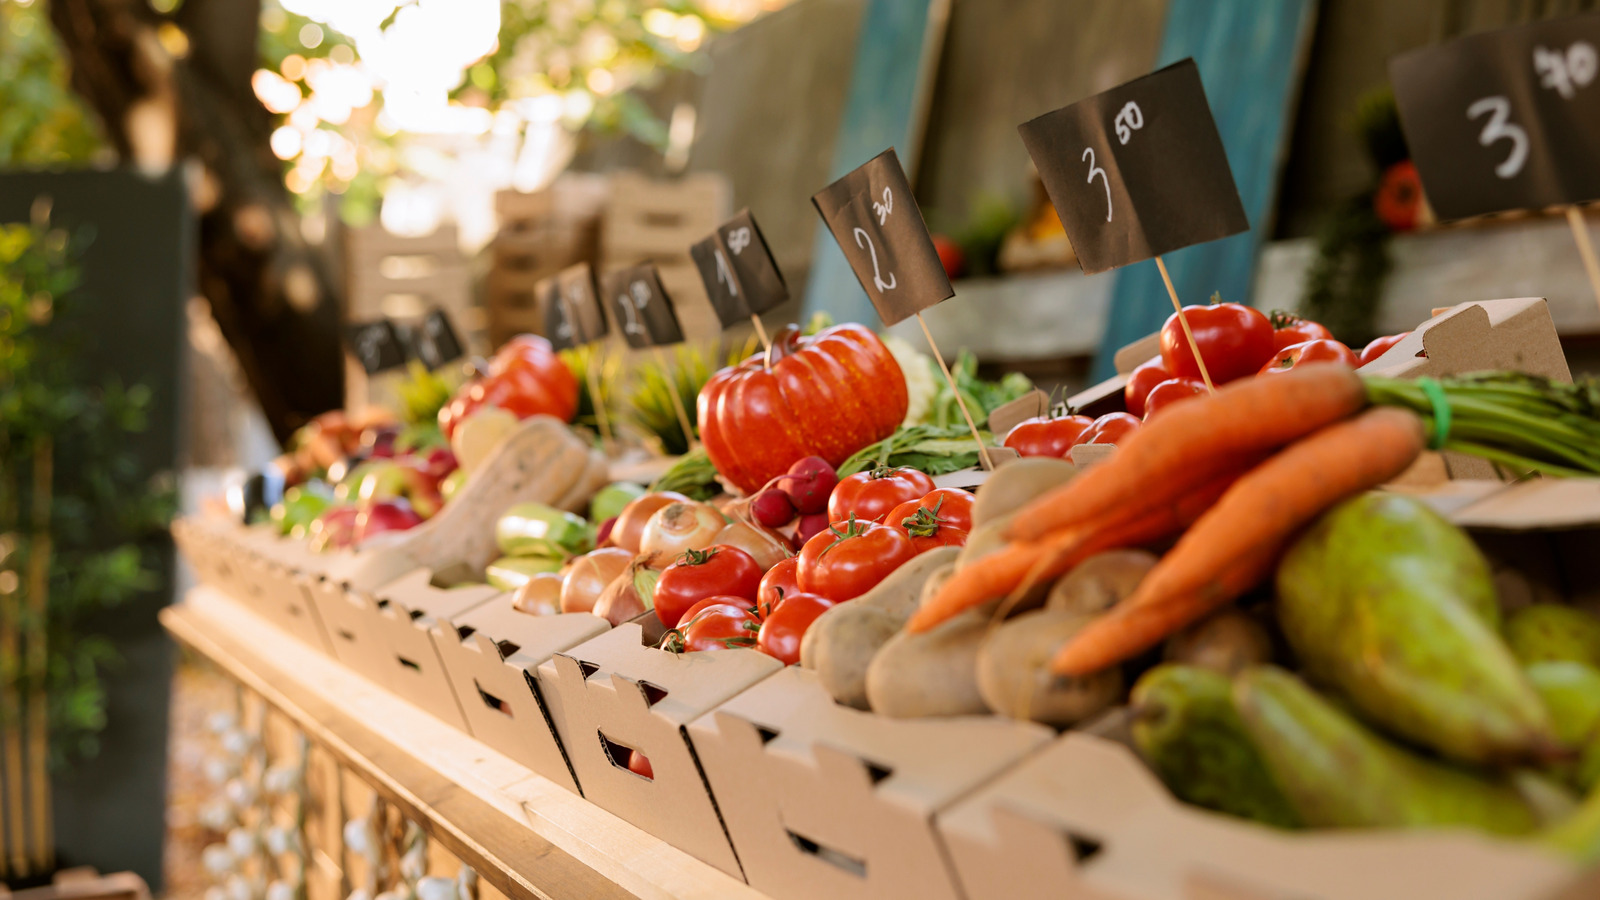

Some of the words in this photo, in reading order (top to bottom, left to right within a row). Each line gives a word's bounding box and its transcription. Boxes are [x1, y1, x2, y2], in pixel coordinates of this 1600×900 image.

[1082, 147, 1112, 222] 3
[1114, 101, 1144, 145] 50
[1466, 96, 1530, 179] 3
[873, 186, 893, 226] 30
[853, 227, 897, 293] 2
